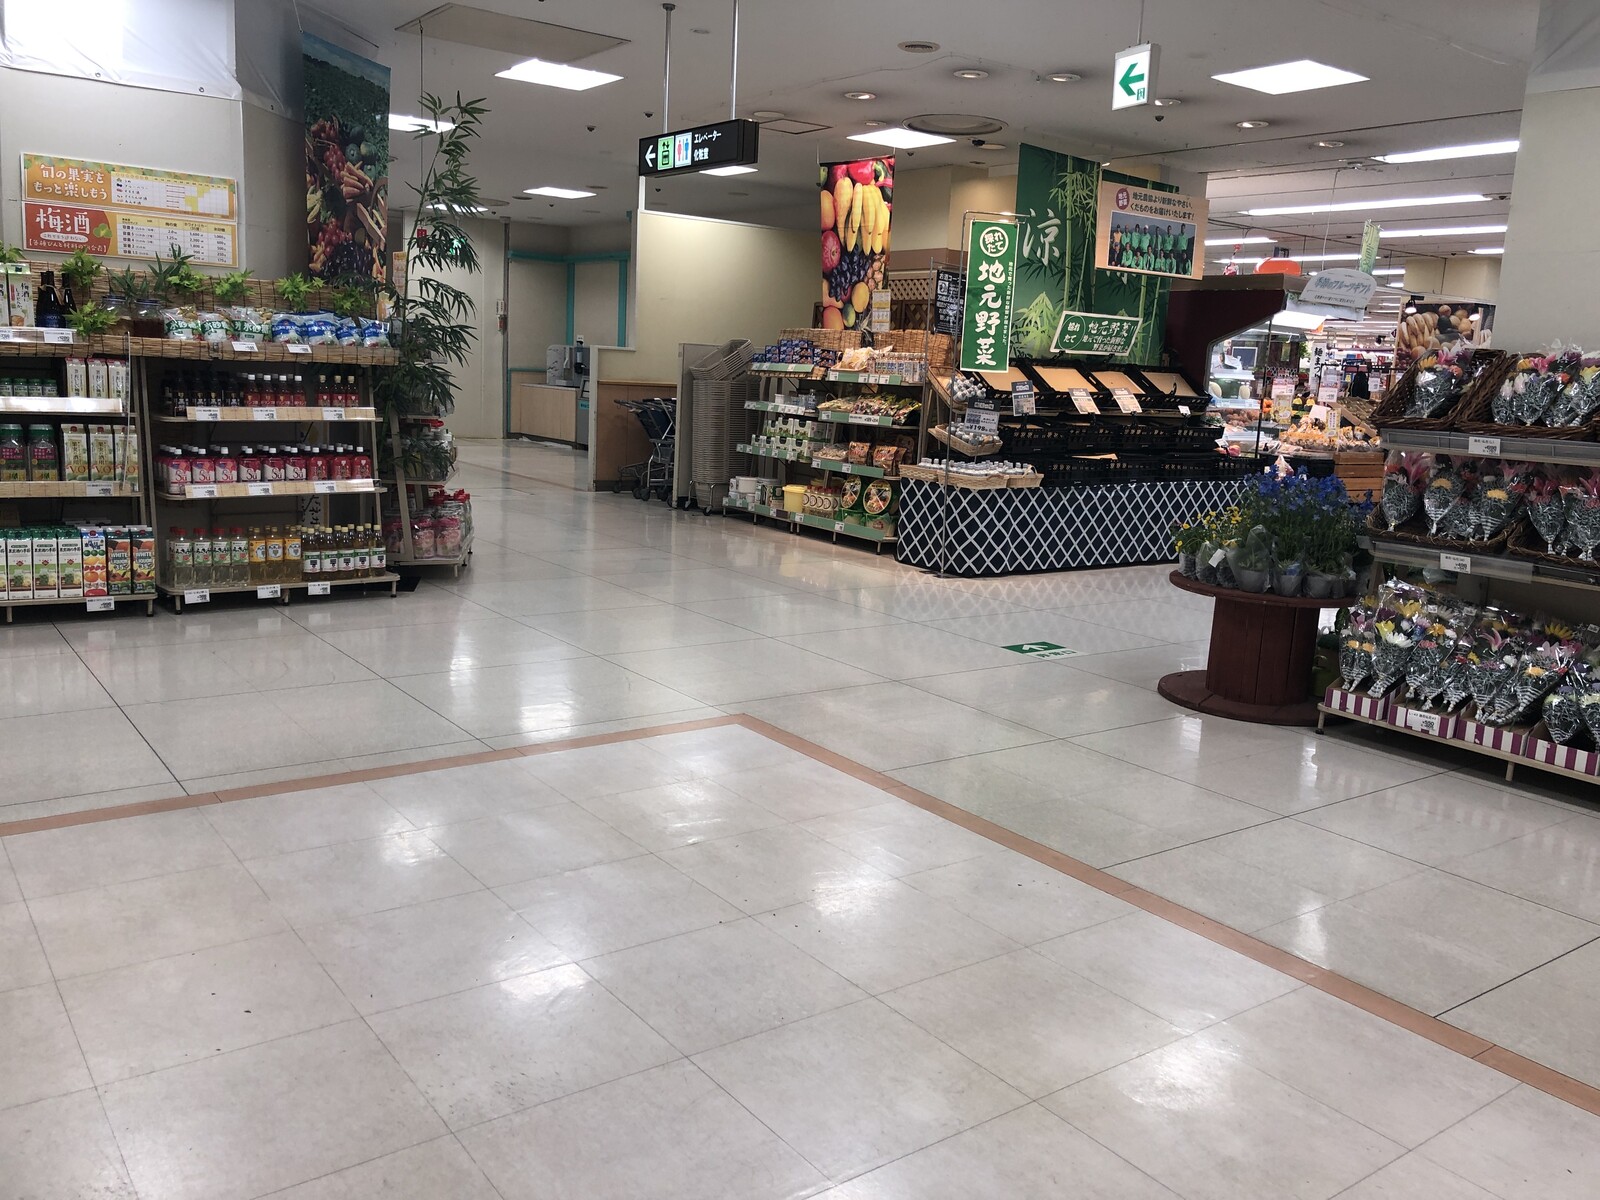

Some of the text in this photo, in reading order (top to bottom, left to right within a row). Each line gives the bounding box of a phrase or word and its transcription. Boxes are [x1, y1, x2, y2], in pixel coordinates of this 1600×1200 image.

[693, 130, 721, 143] エレベーター
[693, 147, 709, 161] 化粧室
[40, 164, 104, 184] 旬の果実を
[33, 182, 108, 200] もっと楽しもう
[36, 207, 90, 234] 梅酒
[984, 232, 1003, 246] 採れ
[1022, 208, 1061, 267] 涼
[986, 242, 1004, 253] たて
[975, 260, 1006, 367] 地元野菜
